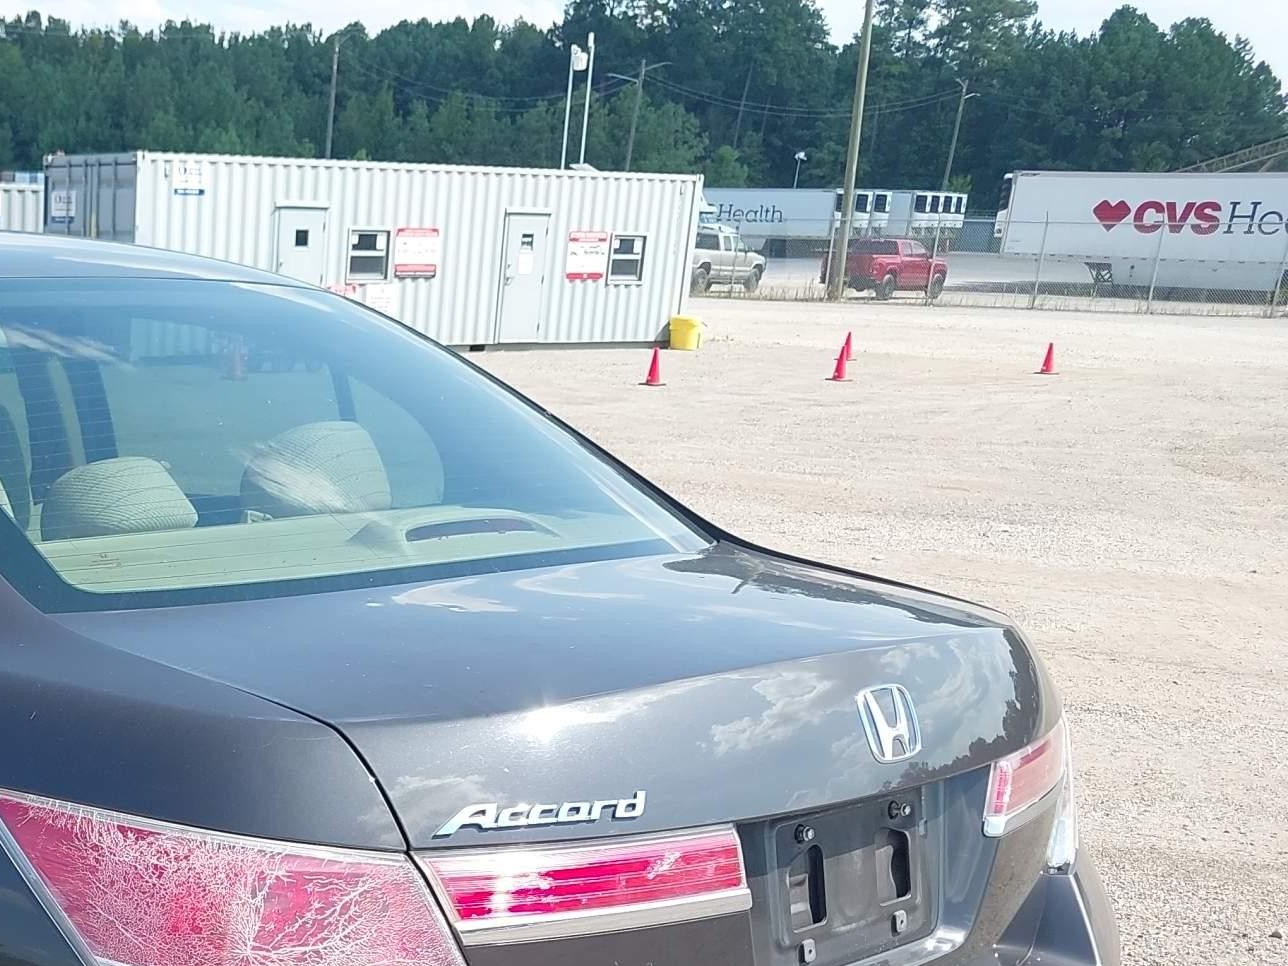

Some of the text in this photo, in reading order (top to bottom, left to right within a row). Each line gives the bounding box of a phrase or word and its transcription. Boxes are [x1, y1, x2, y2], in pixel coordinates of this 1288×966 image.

[717, 203, 784, 223] Health
[1133, 200, 1288, 236] CVS He
[431, 790, 647, 840] Accord
